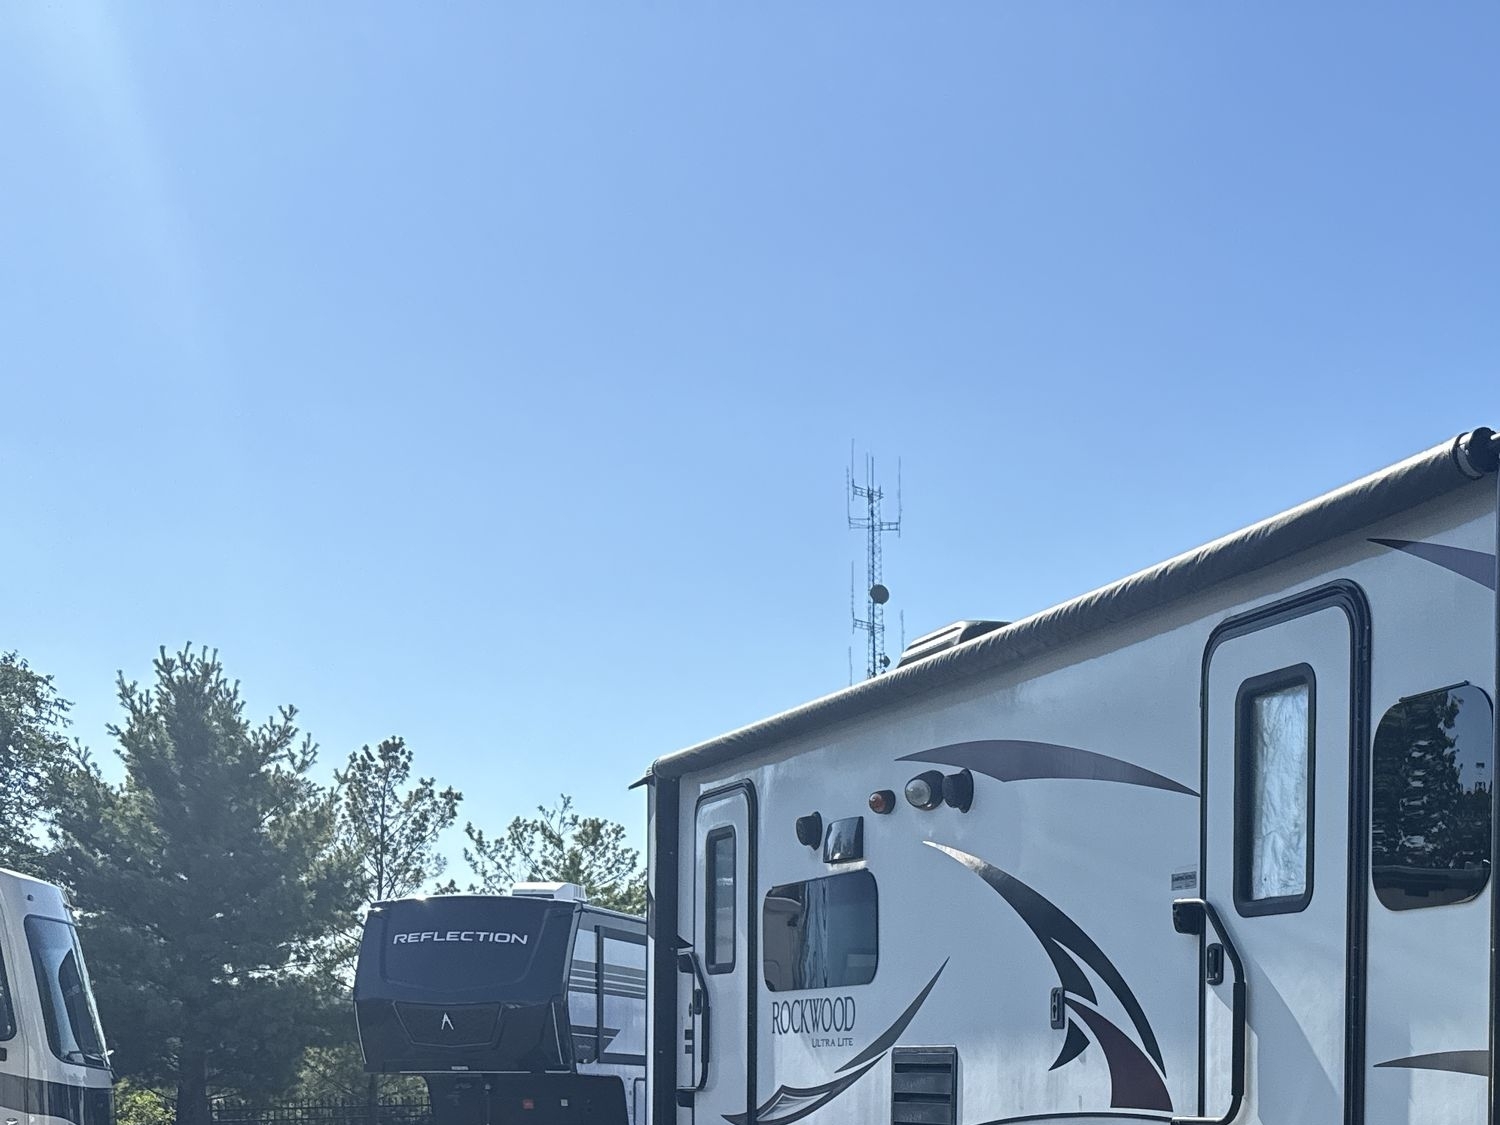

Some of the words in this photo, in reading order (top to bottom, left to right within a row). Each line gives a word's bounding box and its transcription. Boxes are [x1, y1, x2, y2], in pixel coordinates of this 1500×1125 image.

[394, 931, 528, 945] REFLECTION
[772, 996, 856, 1035] ROCKWOOD
[811, 1038, 836, 1048] ULTRA
[837, 1037, 854, 1047] LITE
